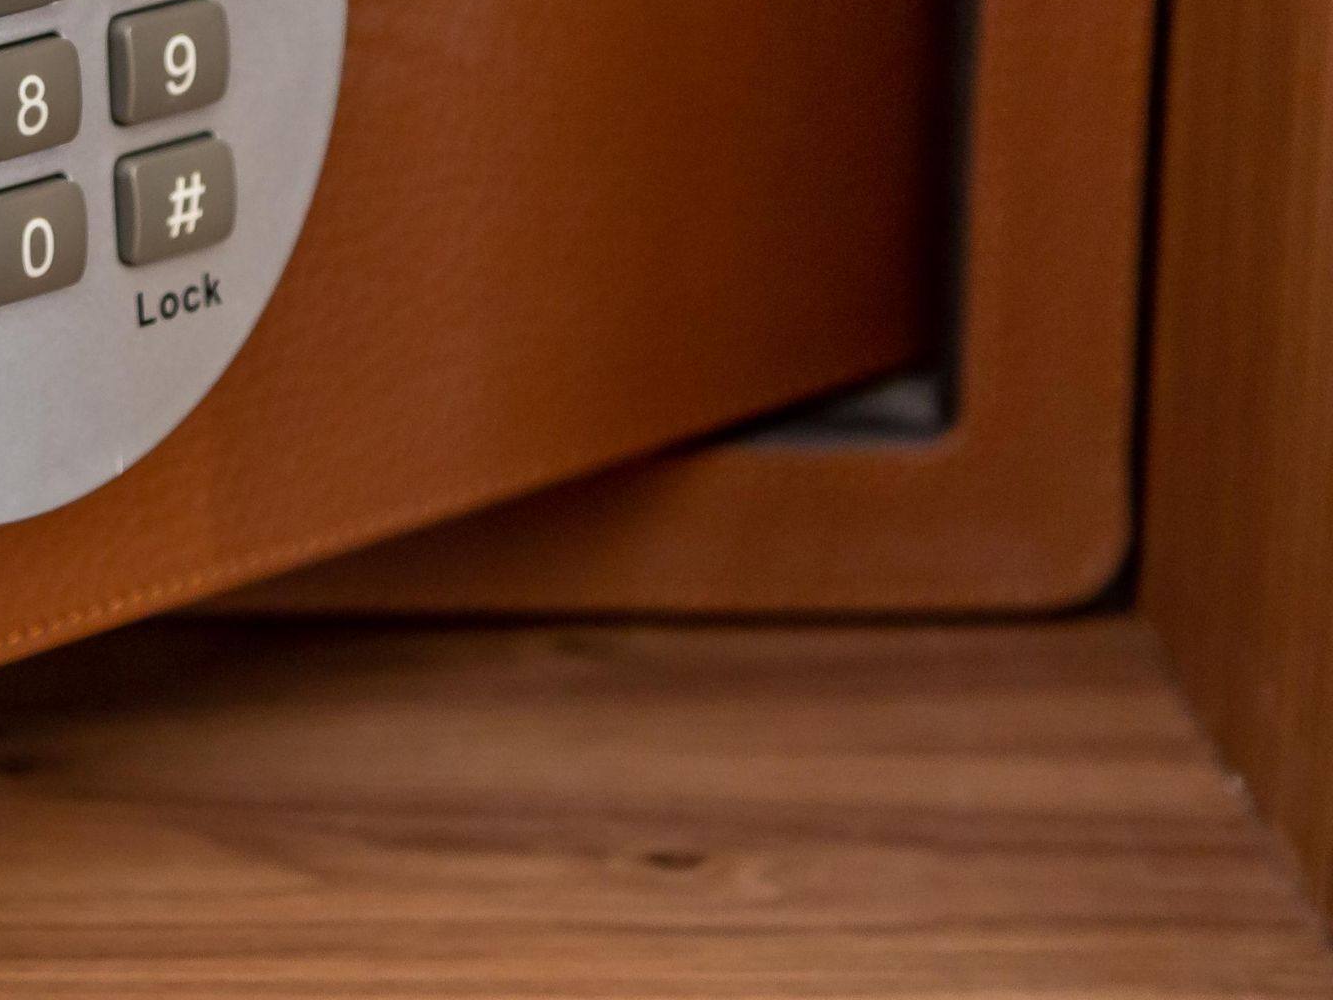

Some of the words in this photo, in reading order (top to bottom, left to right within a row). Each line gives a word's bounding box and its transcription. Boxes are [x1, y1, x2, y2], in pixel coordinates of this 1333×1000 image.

[164, 35, 197, 96] 9
[18, 74, 48, 137] 8
[166, 170, 207, 239] #
[22, 217, 55, 279] 0
[136, 272, 223, 329] Lock
